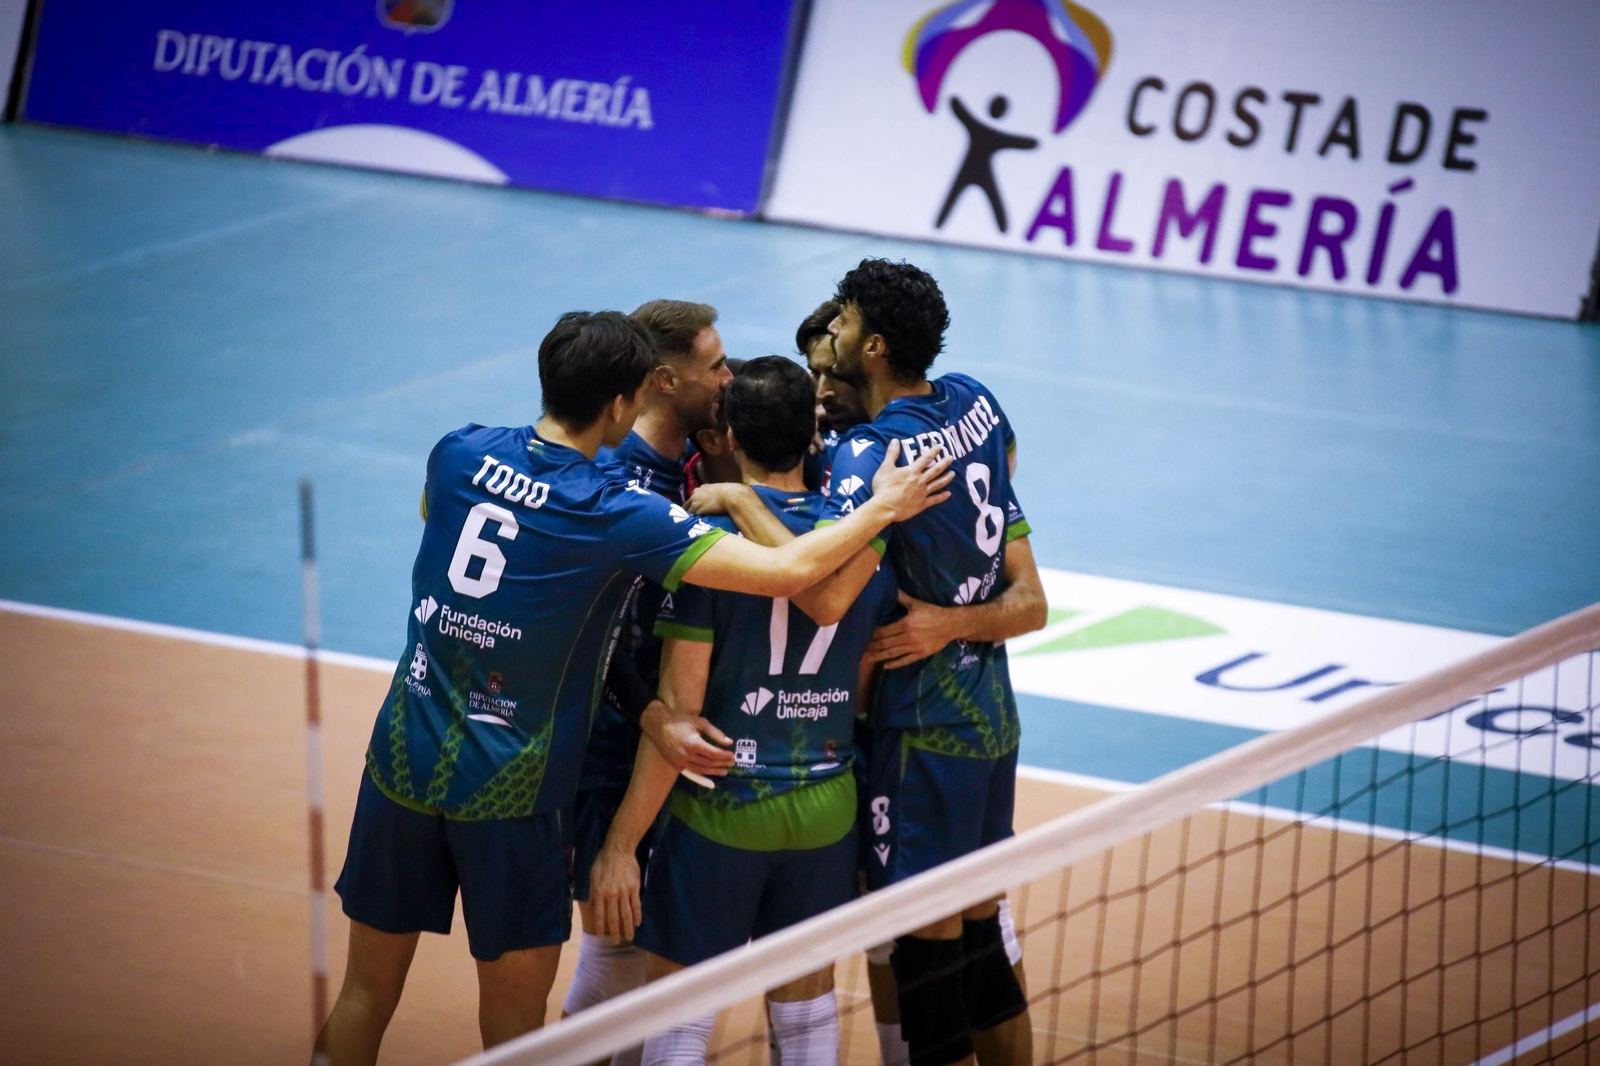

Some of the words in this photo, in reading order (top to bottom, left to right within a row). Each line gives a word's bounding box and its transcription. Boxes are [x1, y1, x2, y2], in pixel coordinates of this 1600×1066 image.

[153, 29, 403, 99] DIPUTACIÓN
[410, 60, 465, 106] DE
[471, 71, 654, 130] ALMERÍA
[1126, 76, 1361, 160] COSTA
[1386, 102, 1489, 172] DE
[1026, 165, 1459, 294] ALMERÍA
[966, 462, 1005, 558] 8
[447, 502, 519, 599] 6
[438, 618, 496, 650] Unicaja
[440, 604, 522, 640] Fundación
[469, 691, 517, 709] DIPUTACIÓN
[469, 700, 480, 709] DE
[776, 705, 828, 721] Unicaja
[778, 688, 849, 704] Fundación
[870, 796, 891, 836] 8
